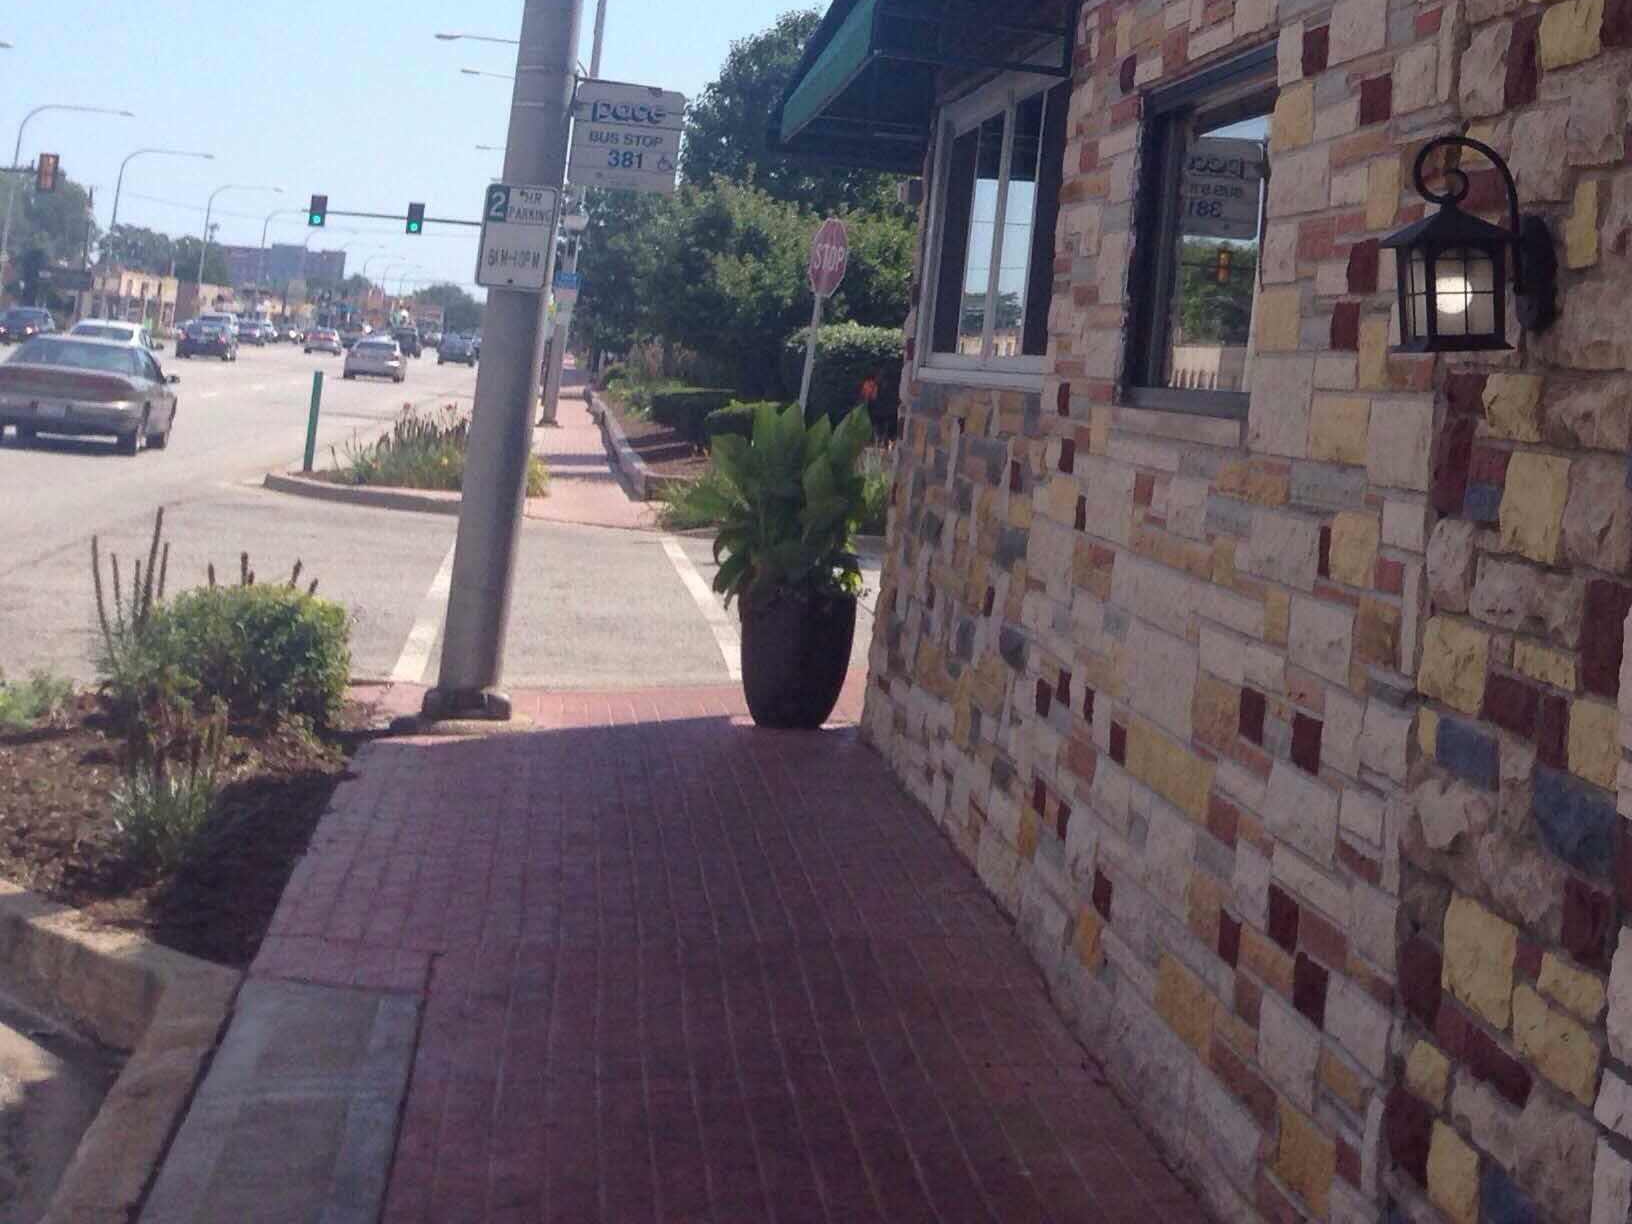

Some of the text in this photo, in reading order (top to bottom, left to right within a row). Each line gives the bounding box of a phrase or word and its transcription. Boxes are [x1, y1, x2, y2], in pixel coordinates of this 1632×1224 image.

[589, 130, 663, 148] BUS STOP
[607, 149, 643, 168] 381
[489, 190, 506, 218] 2
[508, 206, 553, 223] PARKING
[814, 243, 845, 272] STOP
